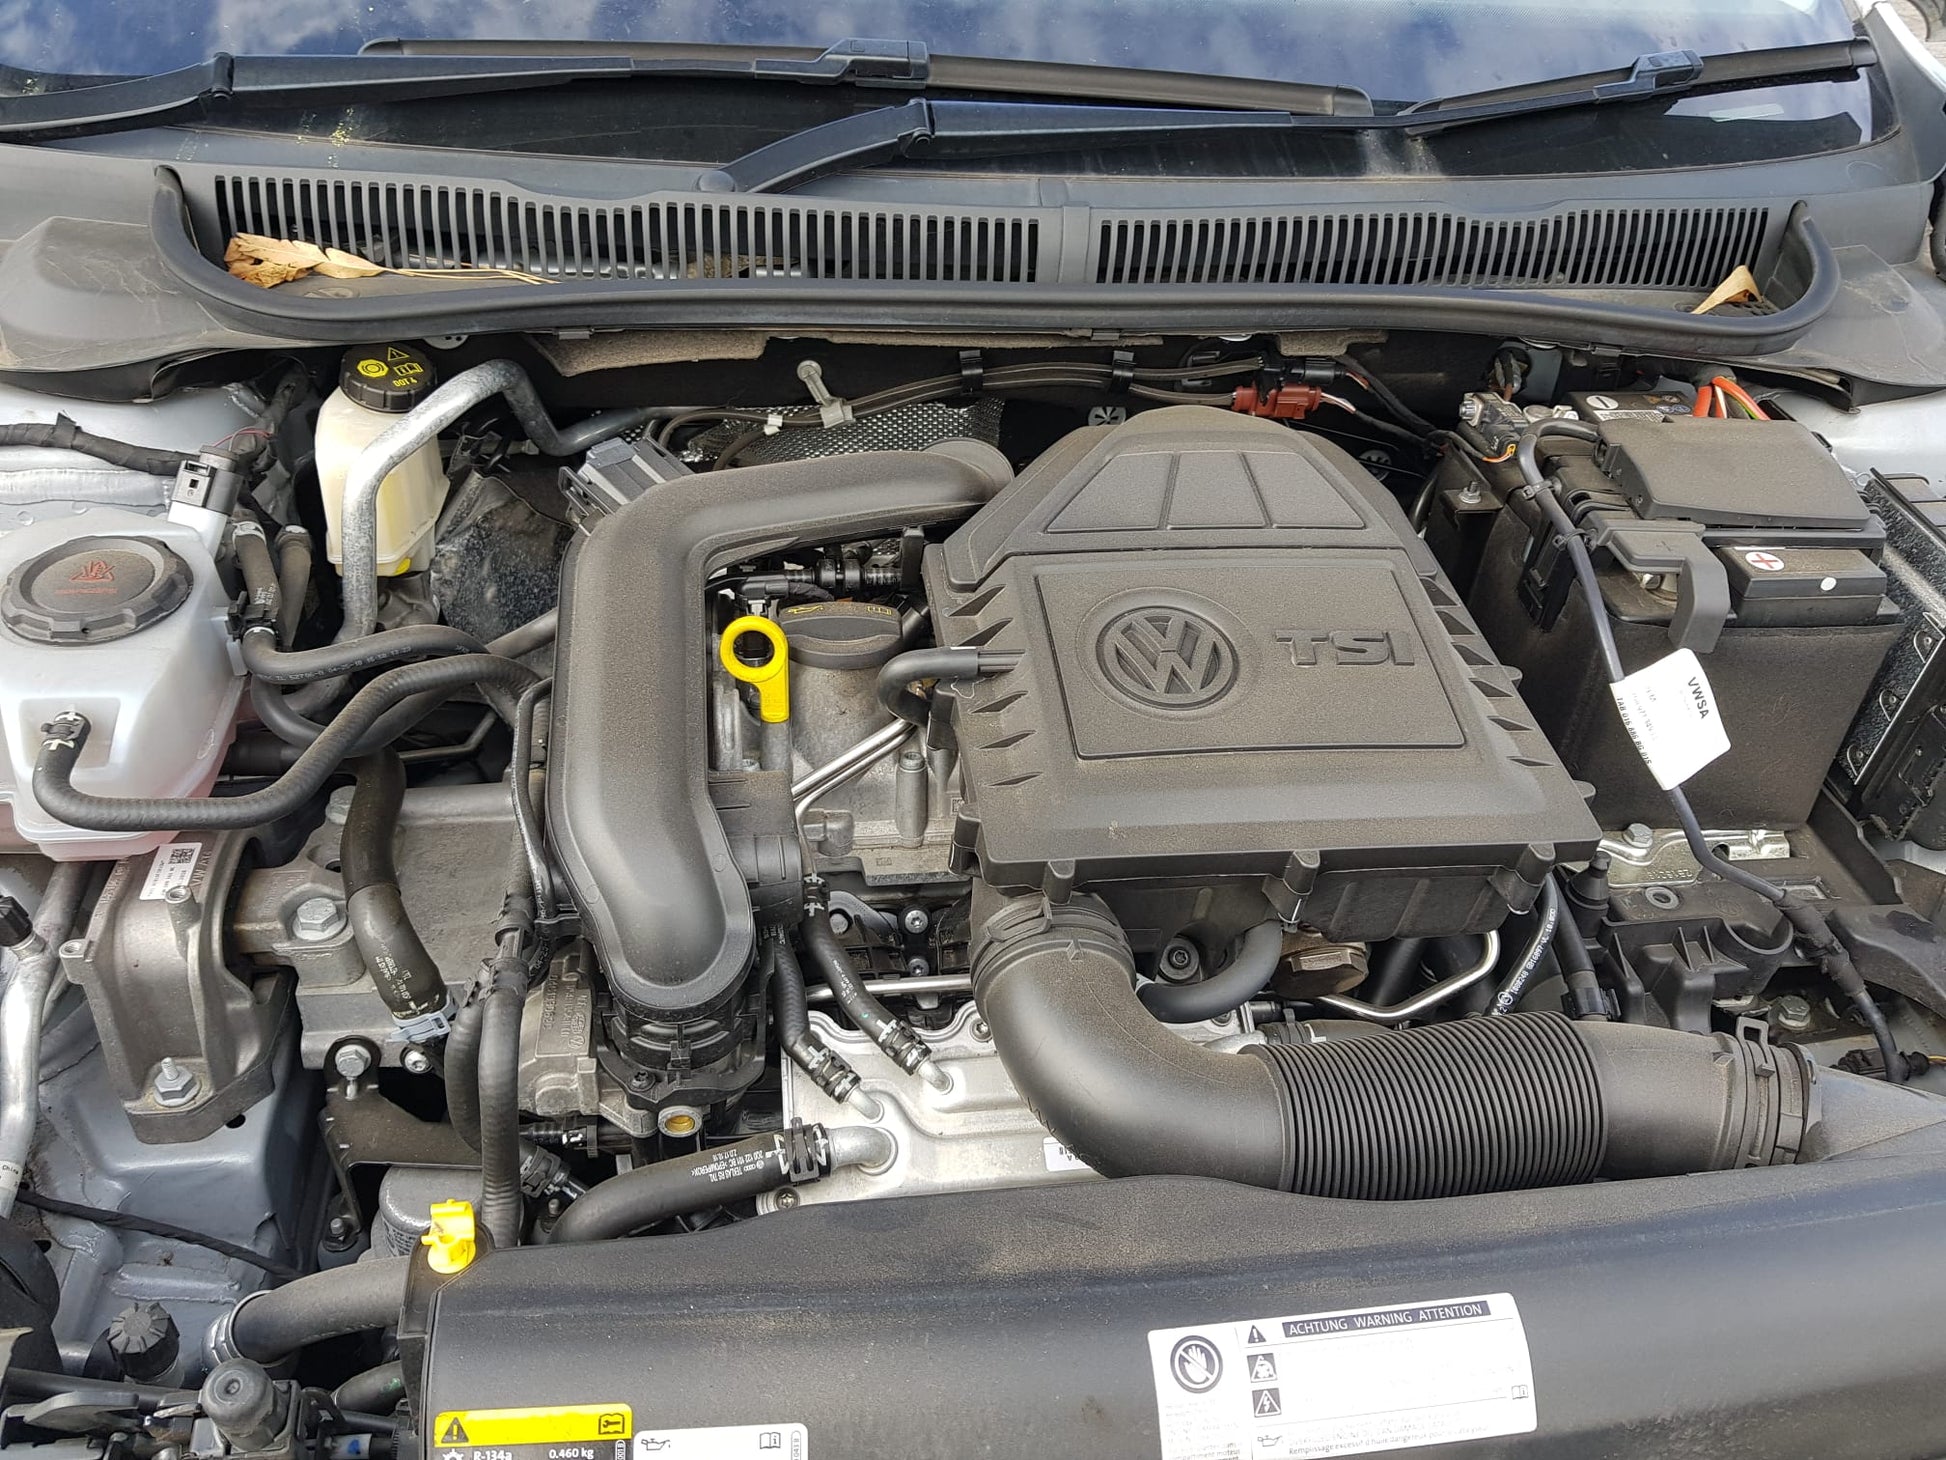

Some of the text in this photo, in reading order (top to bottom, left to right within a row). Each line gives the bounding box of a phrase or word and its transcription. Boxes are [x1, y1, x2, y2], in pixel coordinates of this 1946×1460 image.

[1275, 629, 1416, 667] TSI
[1687, 676, 1709, 719] VWSA
[1288, 1304, 1483, 1336] ACHTUNG WARNING ATTENTION
[472, 1447, 594, 1460] R-134a 0.460 kg
